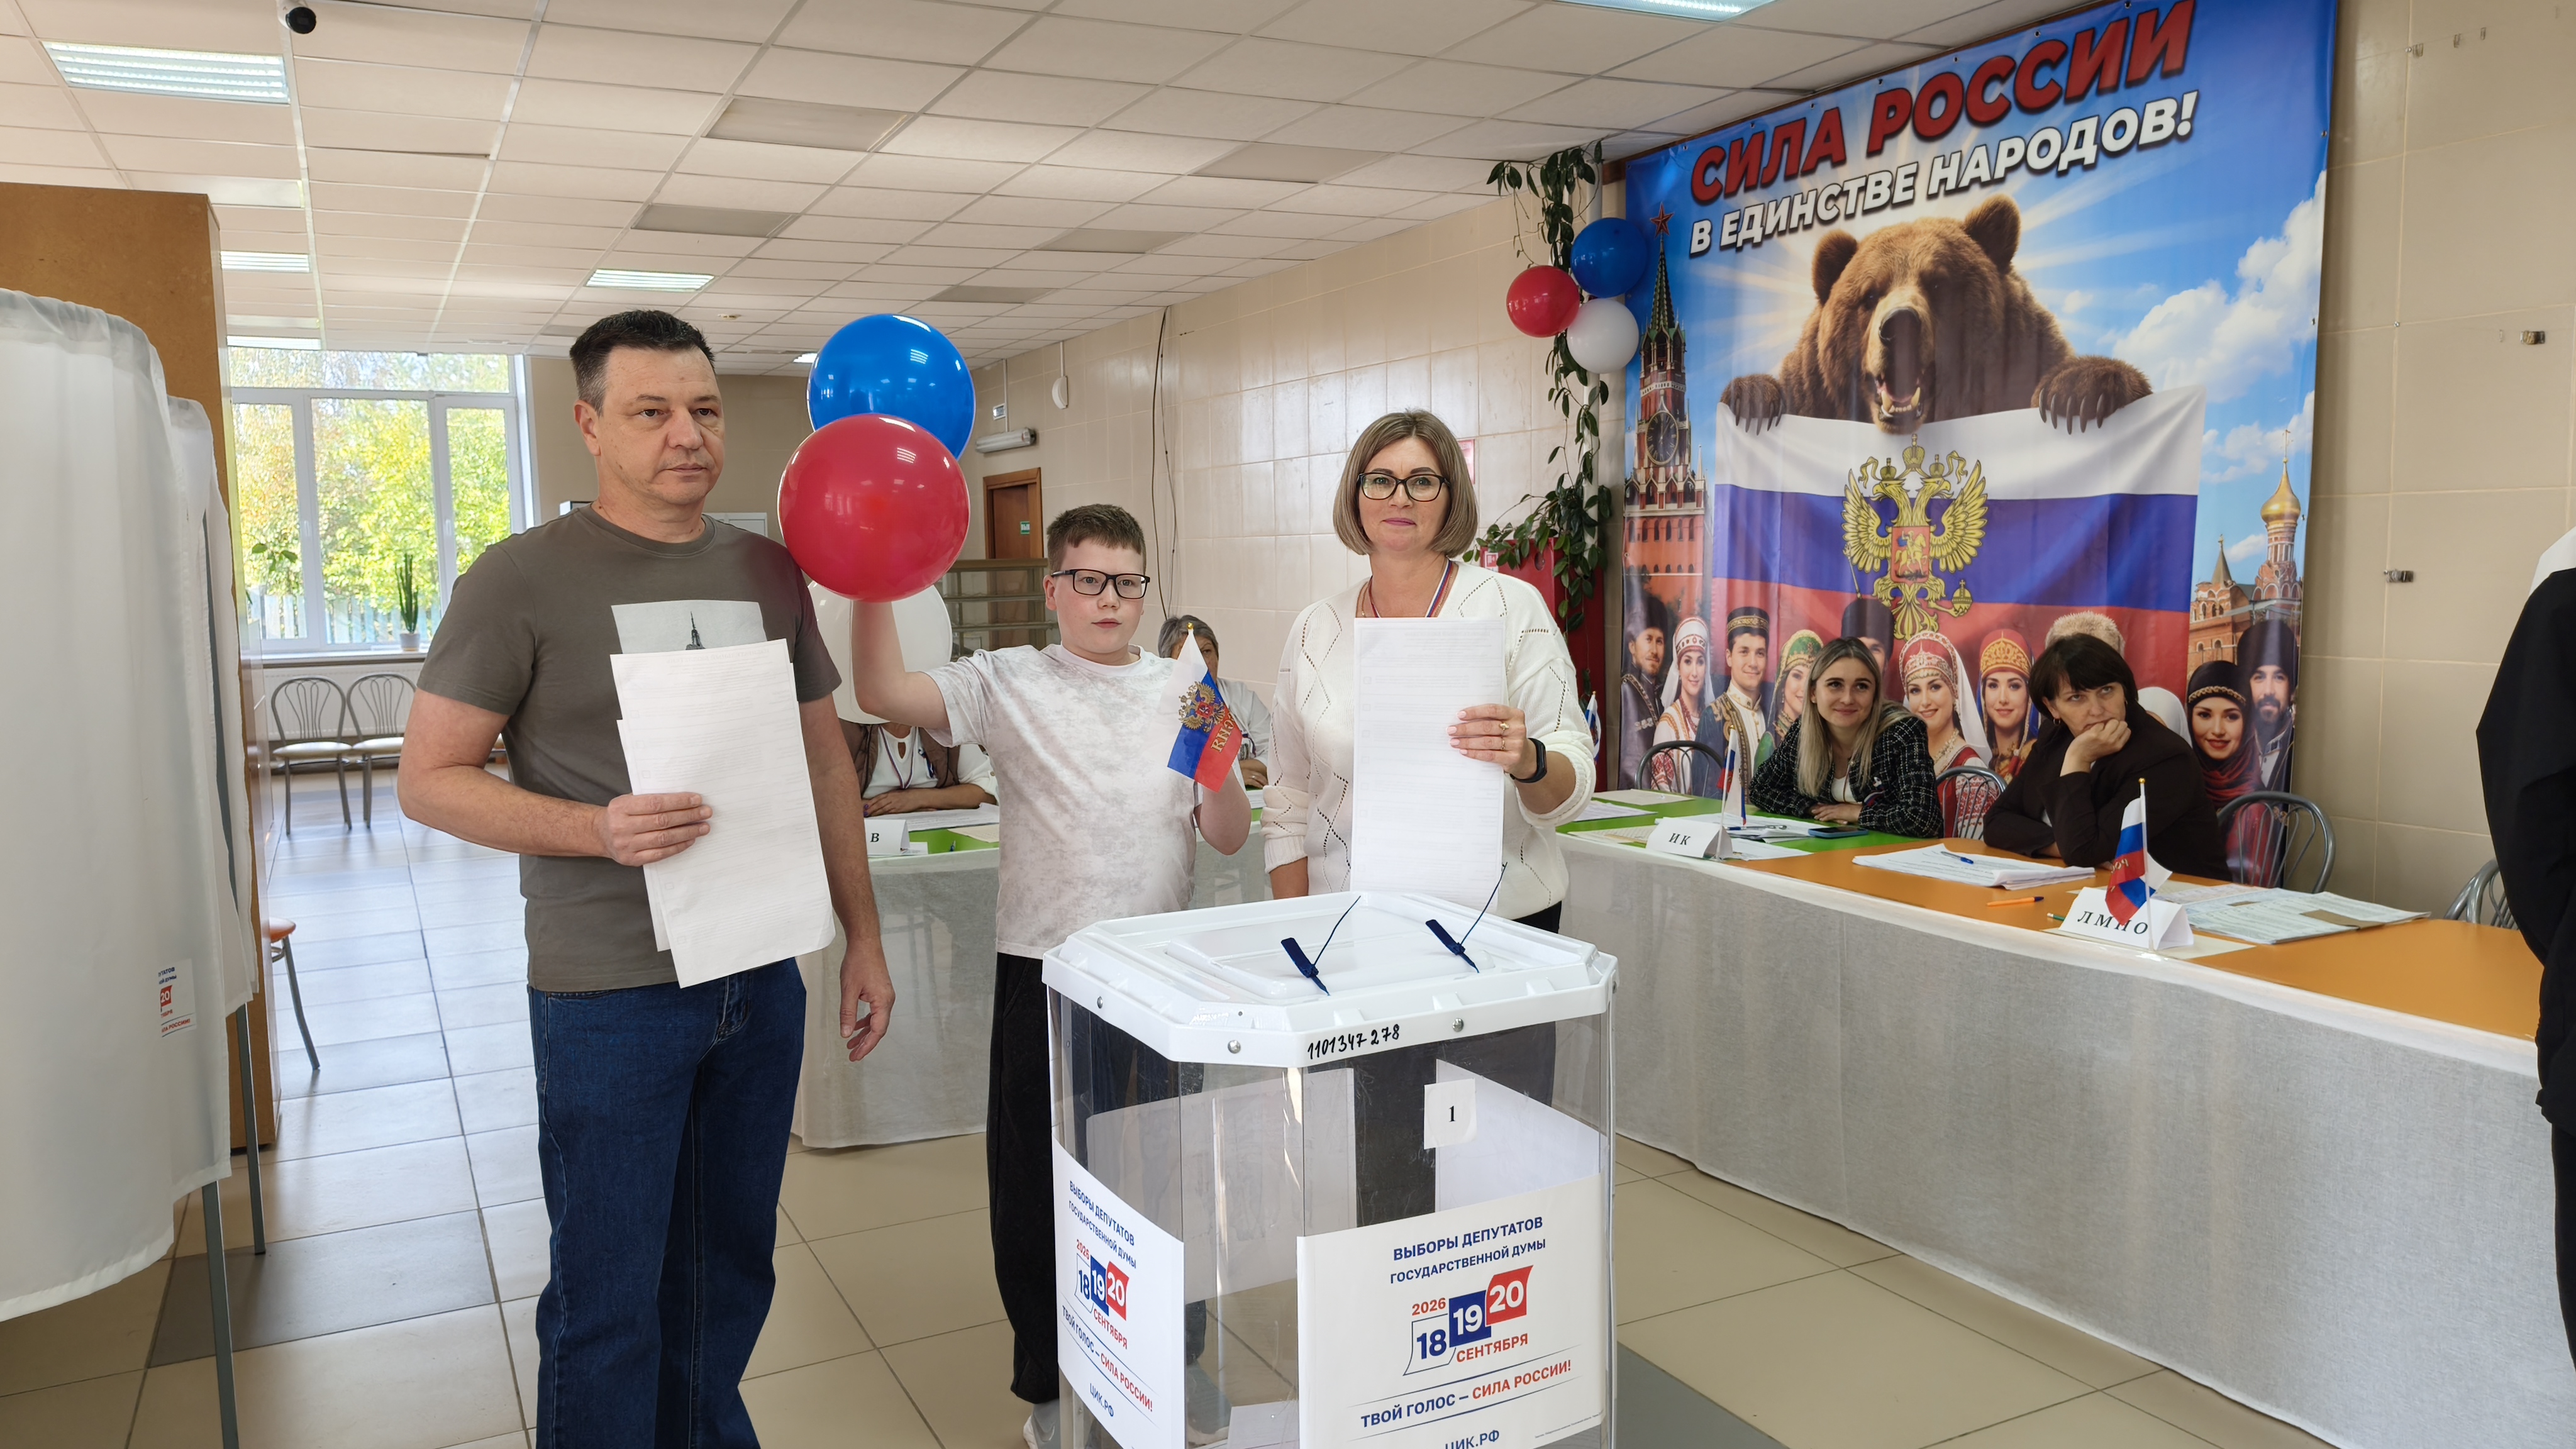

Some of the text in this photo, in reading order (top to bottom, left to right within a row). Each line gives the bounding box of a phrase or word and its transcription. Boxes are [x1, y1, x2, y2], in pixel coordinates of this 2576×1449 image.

[1690, 1, 2195, 203] СИЛА РОССИИ
[1690, 91, 2199, 256] В ЕДИНСТВЕ НАРОДОВ!
[870, 833, 880, 843] В
[161, 991, 170, 1003] 20
[1449, 1106, 1455, 1123] 1
[1070, 1180, 1135, 1246] ВЫБОРЫ ДЕПУТАТОВ
[1069, 1201, 1136, 1269] ГОСУДАРСТВЕННОЙ ДУМЫ
[1077, 1239, 1090, 1260] 2026
[1394, 1216, 1543, 1261] ВЫБОРЫ ДЕПУТАТОВ
[1391, 1239, 1546, 1284] ГОСУДАРСТВЕННОЙ ДУМЫ
[1079, 1269, 1125, 1307] 18 19 20
[1412, 1297, 1446, 1316] 2026
[1094, 1308, 1128, 1350] СЕНТЯБРЯ
[1417, 1280, 1524, 1360] 18 19 20
[1063, 1304, 1075, 1329] ТВОЙ
[1076, 1324, 1094, 1353] ГОЛОС
[1101, 1353, 1119, 1380] СИЛА
[1120, 1372, 1153, 1413] РОССИИ!
[1457, 1333, 1528, 1363] СЕНТЯБРЯ
[1090, 1383, 1114, 1417] ЦИК.РФ
[1361, 1404, 1402, 1428] ТВОЙ
[1407, 1394, 1455, 1417] ГОЛОС
[1472, 1379, 1511, 1400] СИЛА
[1514, 1360, 1572, 1388] РОССИИ!
